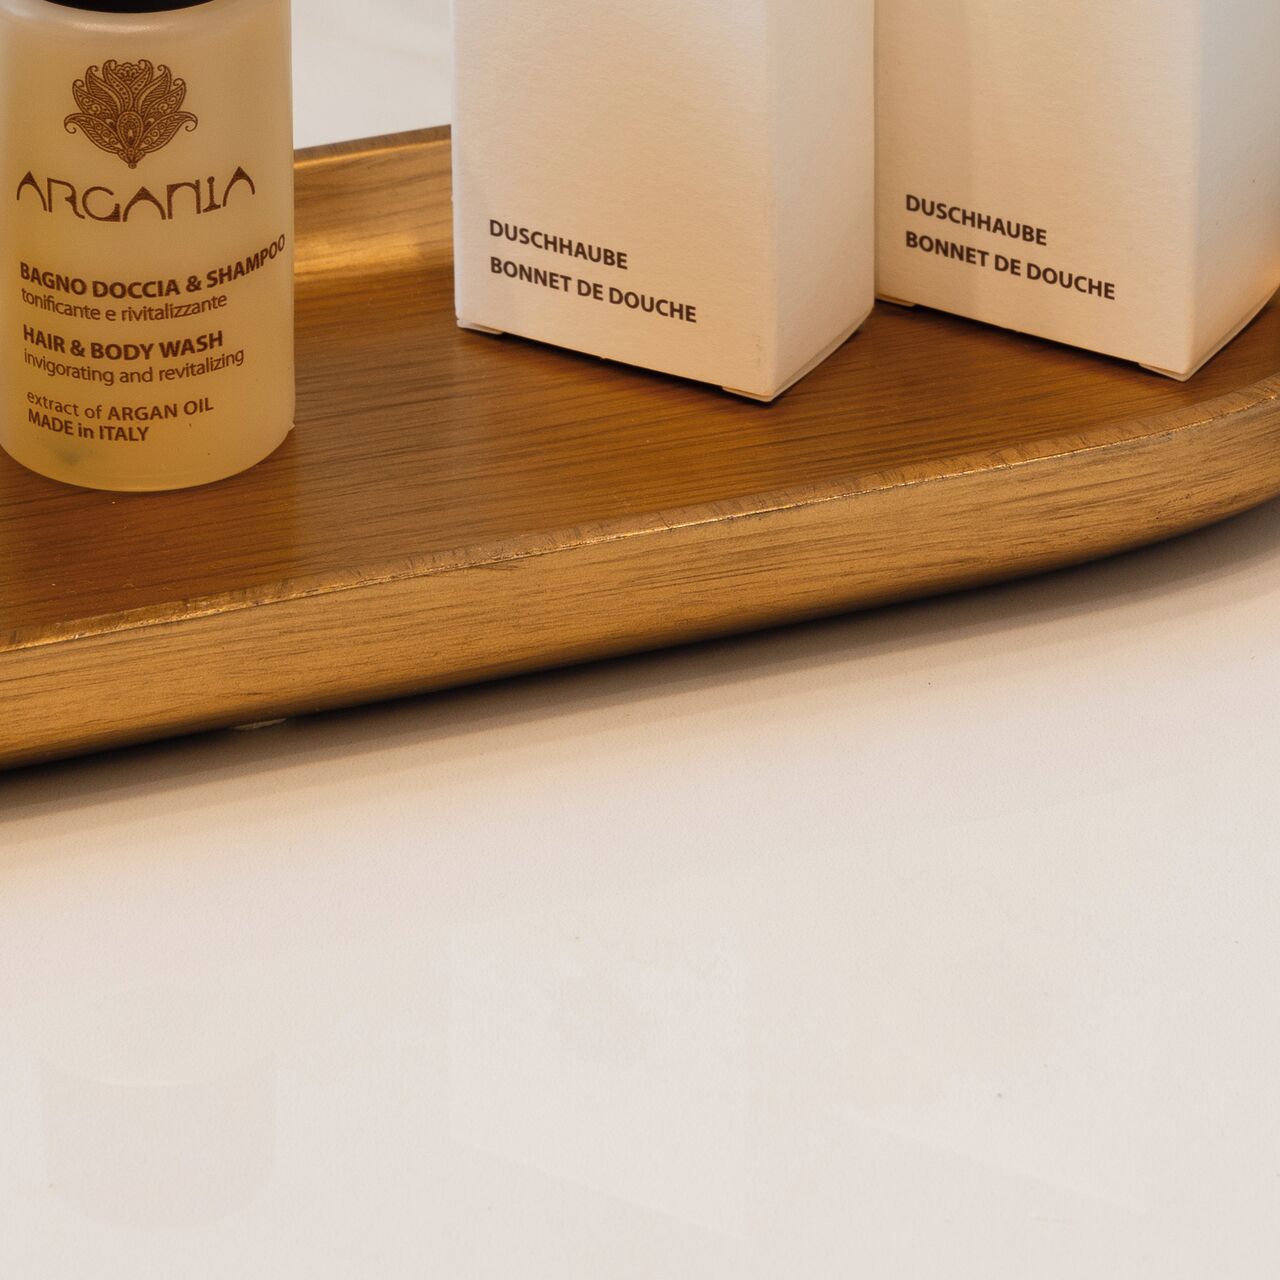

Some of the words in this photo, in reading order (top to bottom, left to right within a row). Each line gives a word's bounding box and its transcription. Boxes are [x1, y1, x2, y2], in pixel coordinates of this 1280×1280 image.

[16, 166, 256, 223] ARGANIA
[905, 193, 1047, 247] DUSCHHAUBE
[19, 261, 88, 296] BAGNO
[91, 278, 181, 299] DOCCIA
[185, 275, 203, 292] &
[206, 233, 286, 289] SHAMPOO
[489, 219, 629, 270] DUSCHHAUBE
[905, 230, 990, 268] BONNET
[994, 254, 1021, 277] DE
[1026, 262, 1116, 301] DOUCHE
[20, 286, 101, 321] tonificante
[104, 307, 117, 321] e
[120, 293, 228, 322] rivitalizzante
[490, 256, 572, 293] BONNET
[576, 278, 604, 301] DE
[608, 286, 697, 324] DOUCHE
[22, 323, 66, 354] HAIR
[69, 339, 86, 358] &
[90, 341, 154, 361] BODY
[158, 329, 224, 359] WASH
[23, 348, 115, 386] invigorating
[119, 366, 153, 384] and
[158, 348, 245, 382] revitalizing
[26, 389, 80, 418] extract
[84, 403, 103, 420] of
[106, 402, 178, 422] ARGAN
[182, 396, 215, 416] OIL
[27, 407, 74, 437] MADE
[77, 422, 95, 440] in
[99, 425, 150, 442] ITALY
